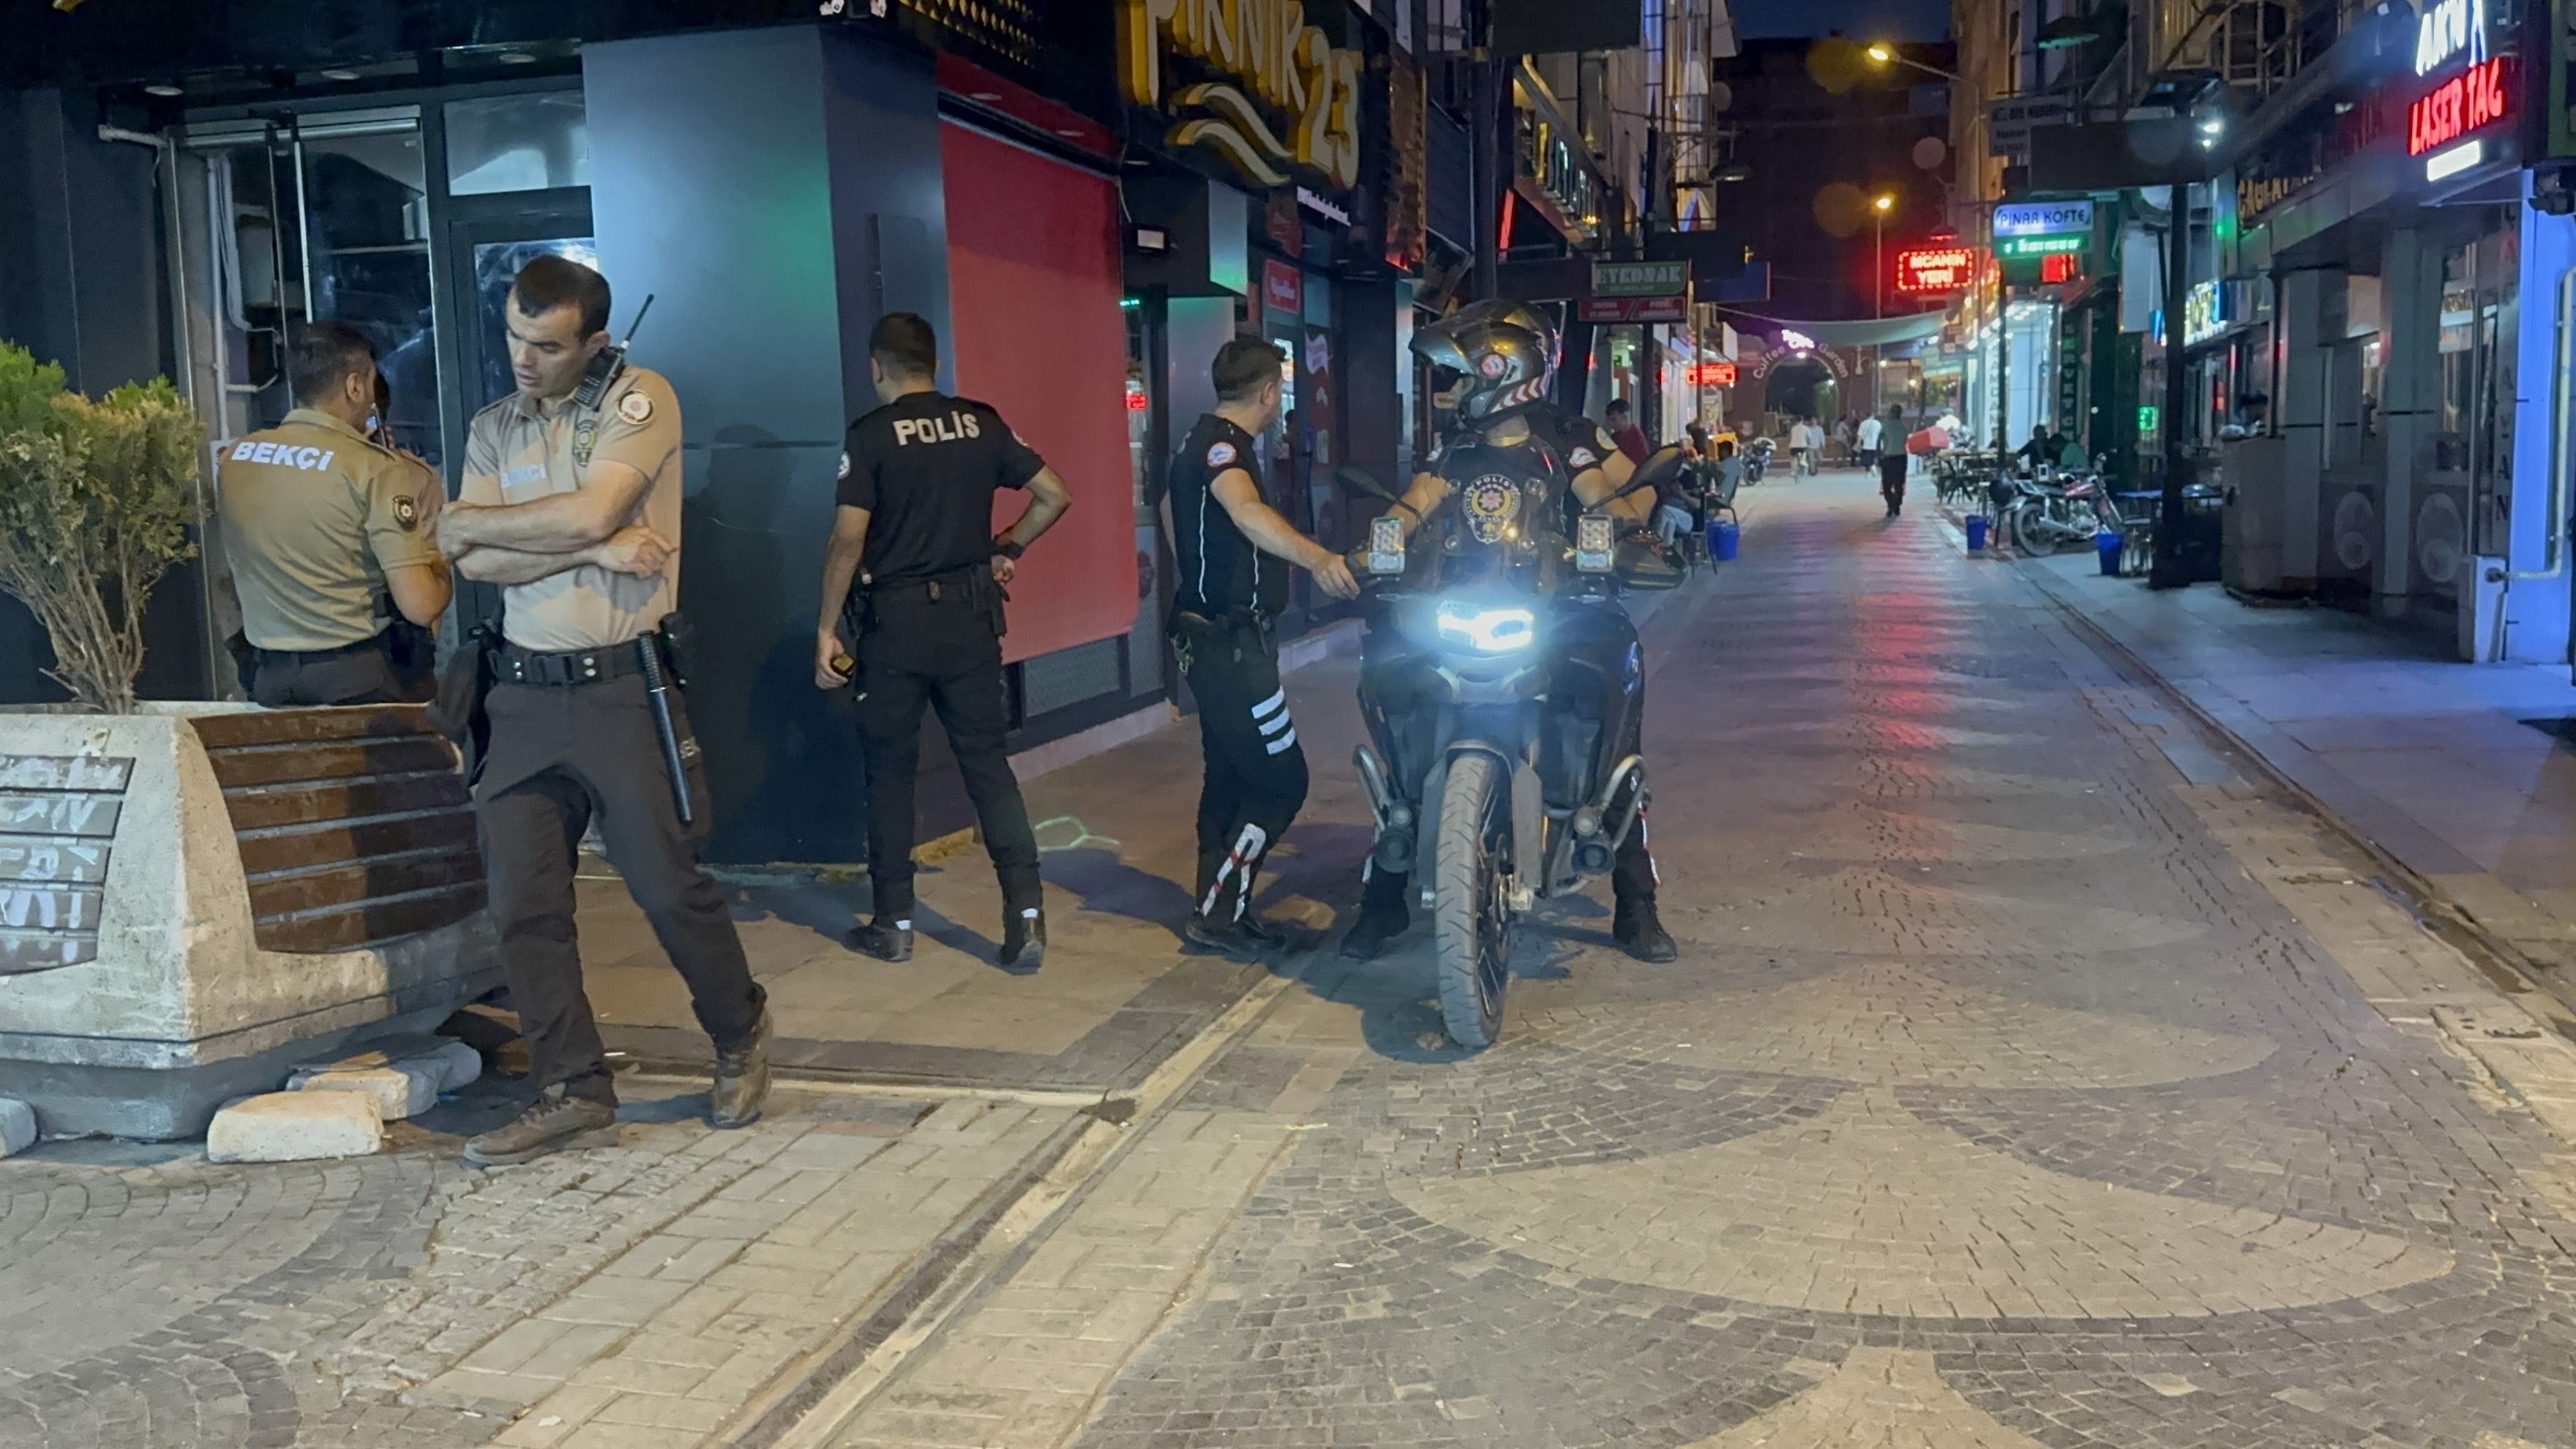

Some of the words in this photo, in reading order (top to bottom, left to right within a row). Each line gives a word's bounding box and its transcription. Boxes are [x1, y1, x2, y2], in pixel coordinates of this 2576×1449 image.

[2410, 78, 2463, 157] LASER
[2466, 57, 2504, 130] TAG
[2044, 206, 2085, 224] KÖFTE
[1818, 342, 1849, 378] Garden
[893, 410, 981, 446] POLİS
[231, 441, 334, 471] BEKÇİ
